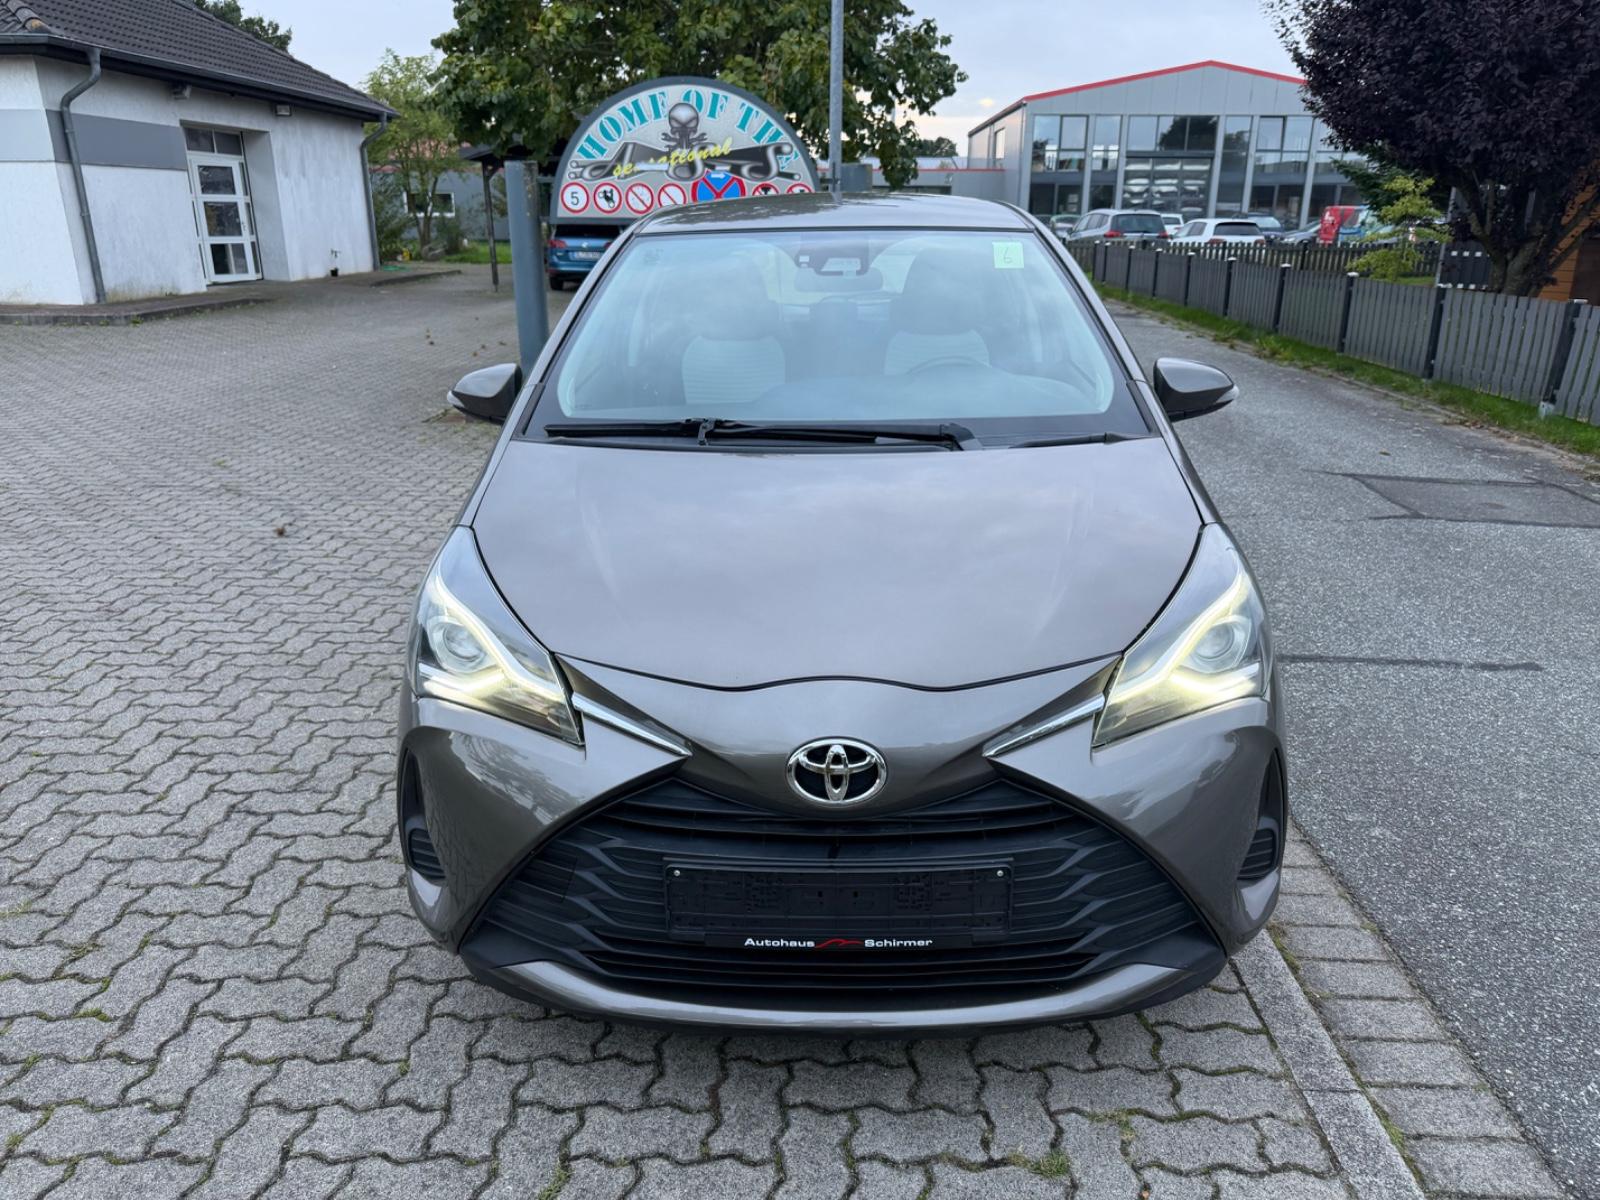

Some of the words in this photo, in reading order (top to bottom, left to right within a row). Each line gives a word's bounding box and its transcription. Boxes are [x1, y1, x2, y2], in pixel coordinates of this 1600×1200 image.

[576, 90, 668, 161] HOME
[682, 88, 729, 120] OF
[570, 191, 580, 206] 5
[1003, 247, 1012, 264] 6
[744, 937, 815, 948] Autohaus
[864, 937, 933, 948] Schirmer
